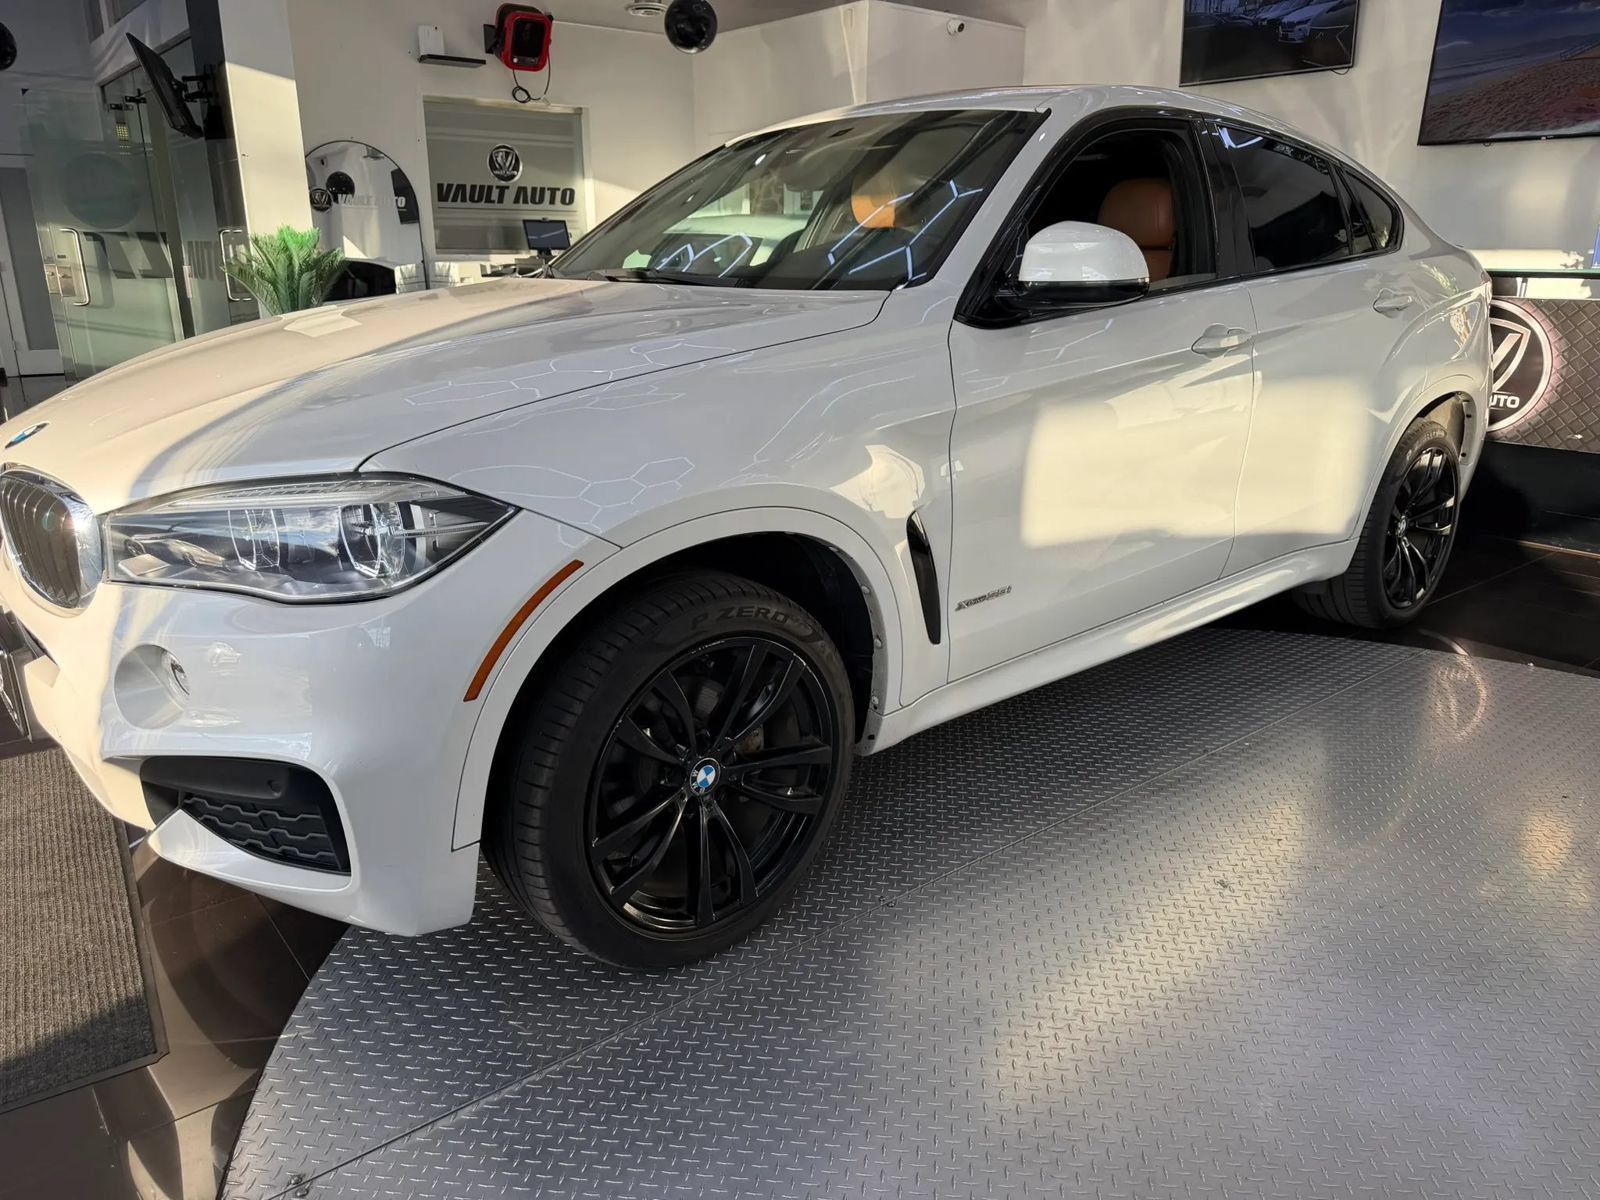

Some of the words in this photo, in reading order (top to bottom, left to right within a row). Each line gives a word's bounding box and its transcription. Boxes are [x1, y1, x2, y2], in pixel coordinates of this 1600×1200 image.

[437, 183, 510, 204] VAULT
[513, 186, 576, 206] AUTO
[1489, 395, 1520, 409] UTO
[690, 612, 708, 630] P
[716, 605, 788, 625] ZERO
